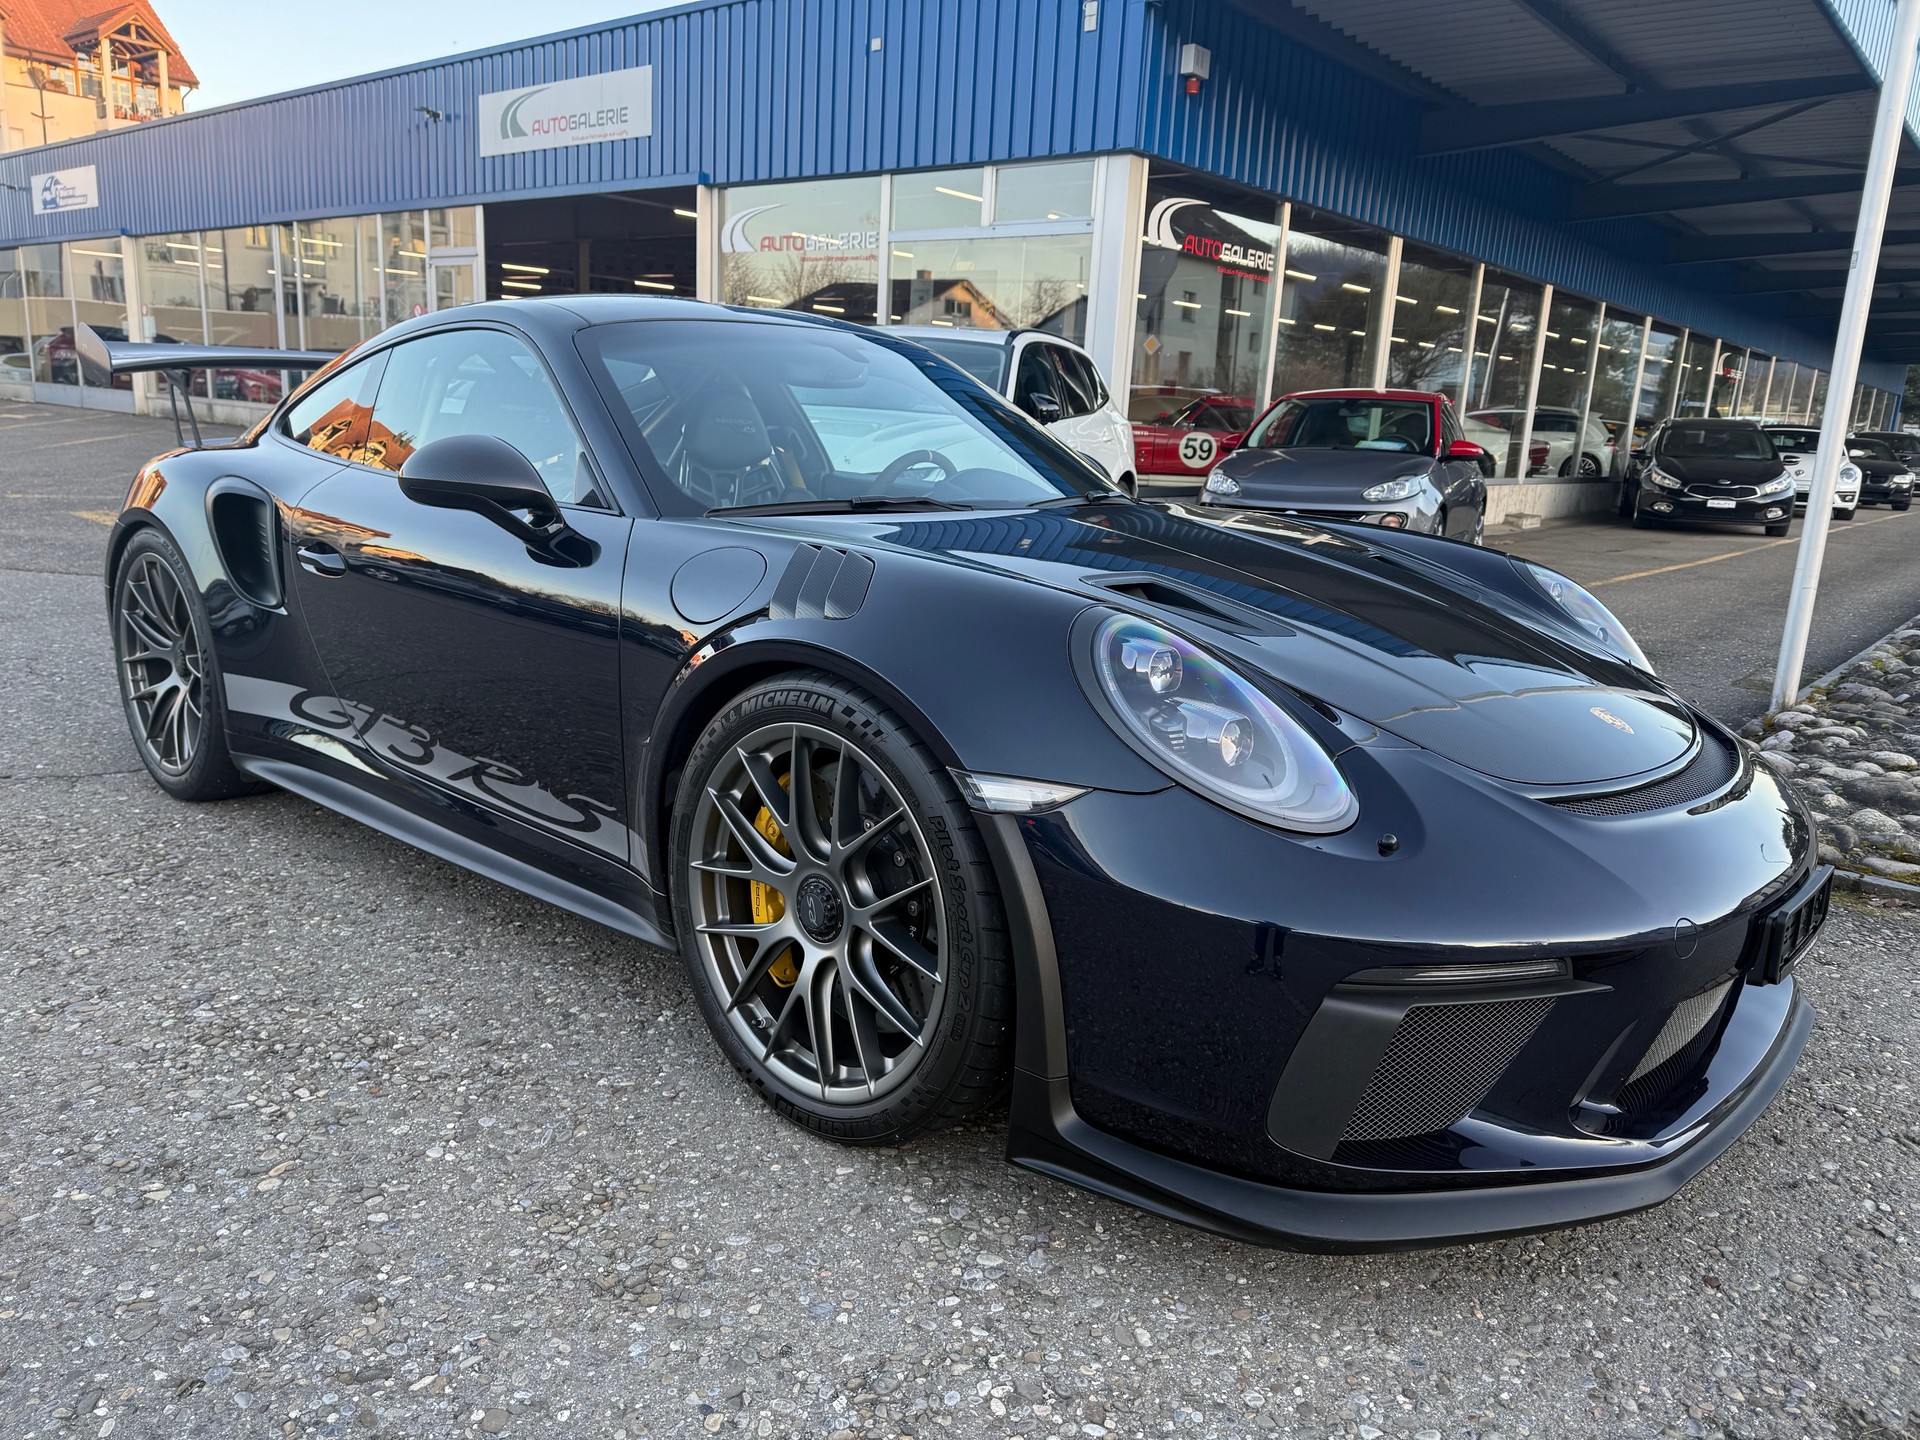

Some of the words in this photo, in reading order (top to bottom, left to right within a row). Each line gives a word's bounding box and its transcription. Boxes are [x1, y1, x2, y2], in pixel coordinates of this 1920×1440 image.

[532, 106, 628, 136] AUTOGALERIE
[760, 231, 878, 252] AUTOGALERIE
[1184, 234, 1275, 272] AUTOGALERIE
[1183, 438, 1213, 460] 59
[740, 690, 836, 718] MICHELIN
[289, 689, 435, 766] GT3
[446, 755, 617, 833] RS
[806, 896, 818, 927] RS
[775, 1101, 870, 1138] MICHELIN
